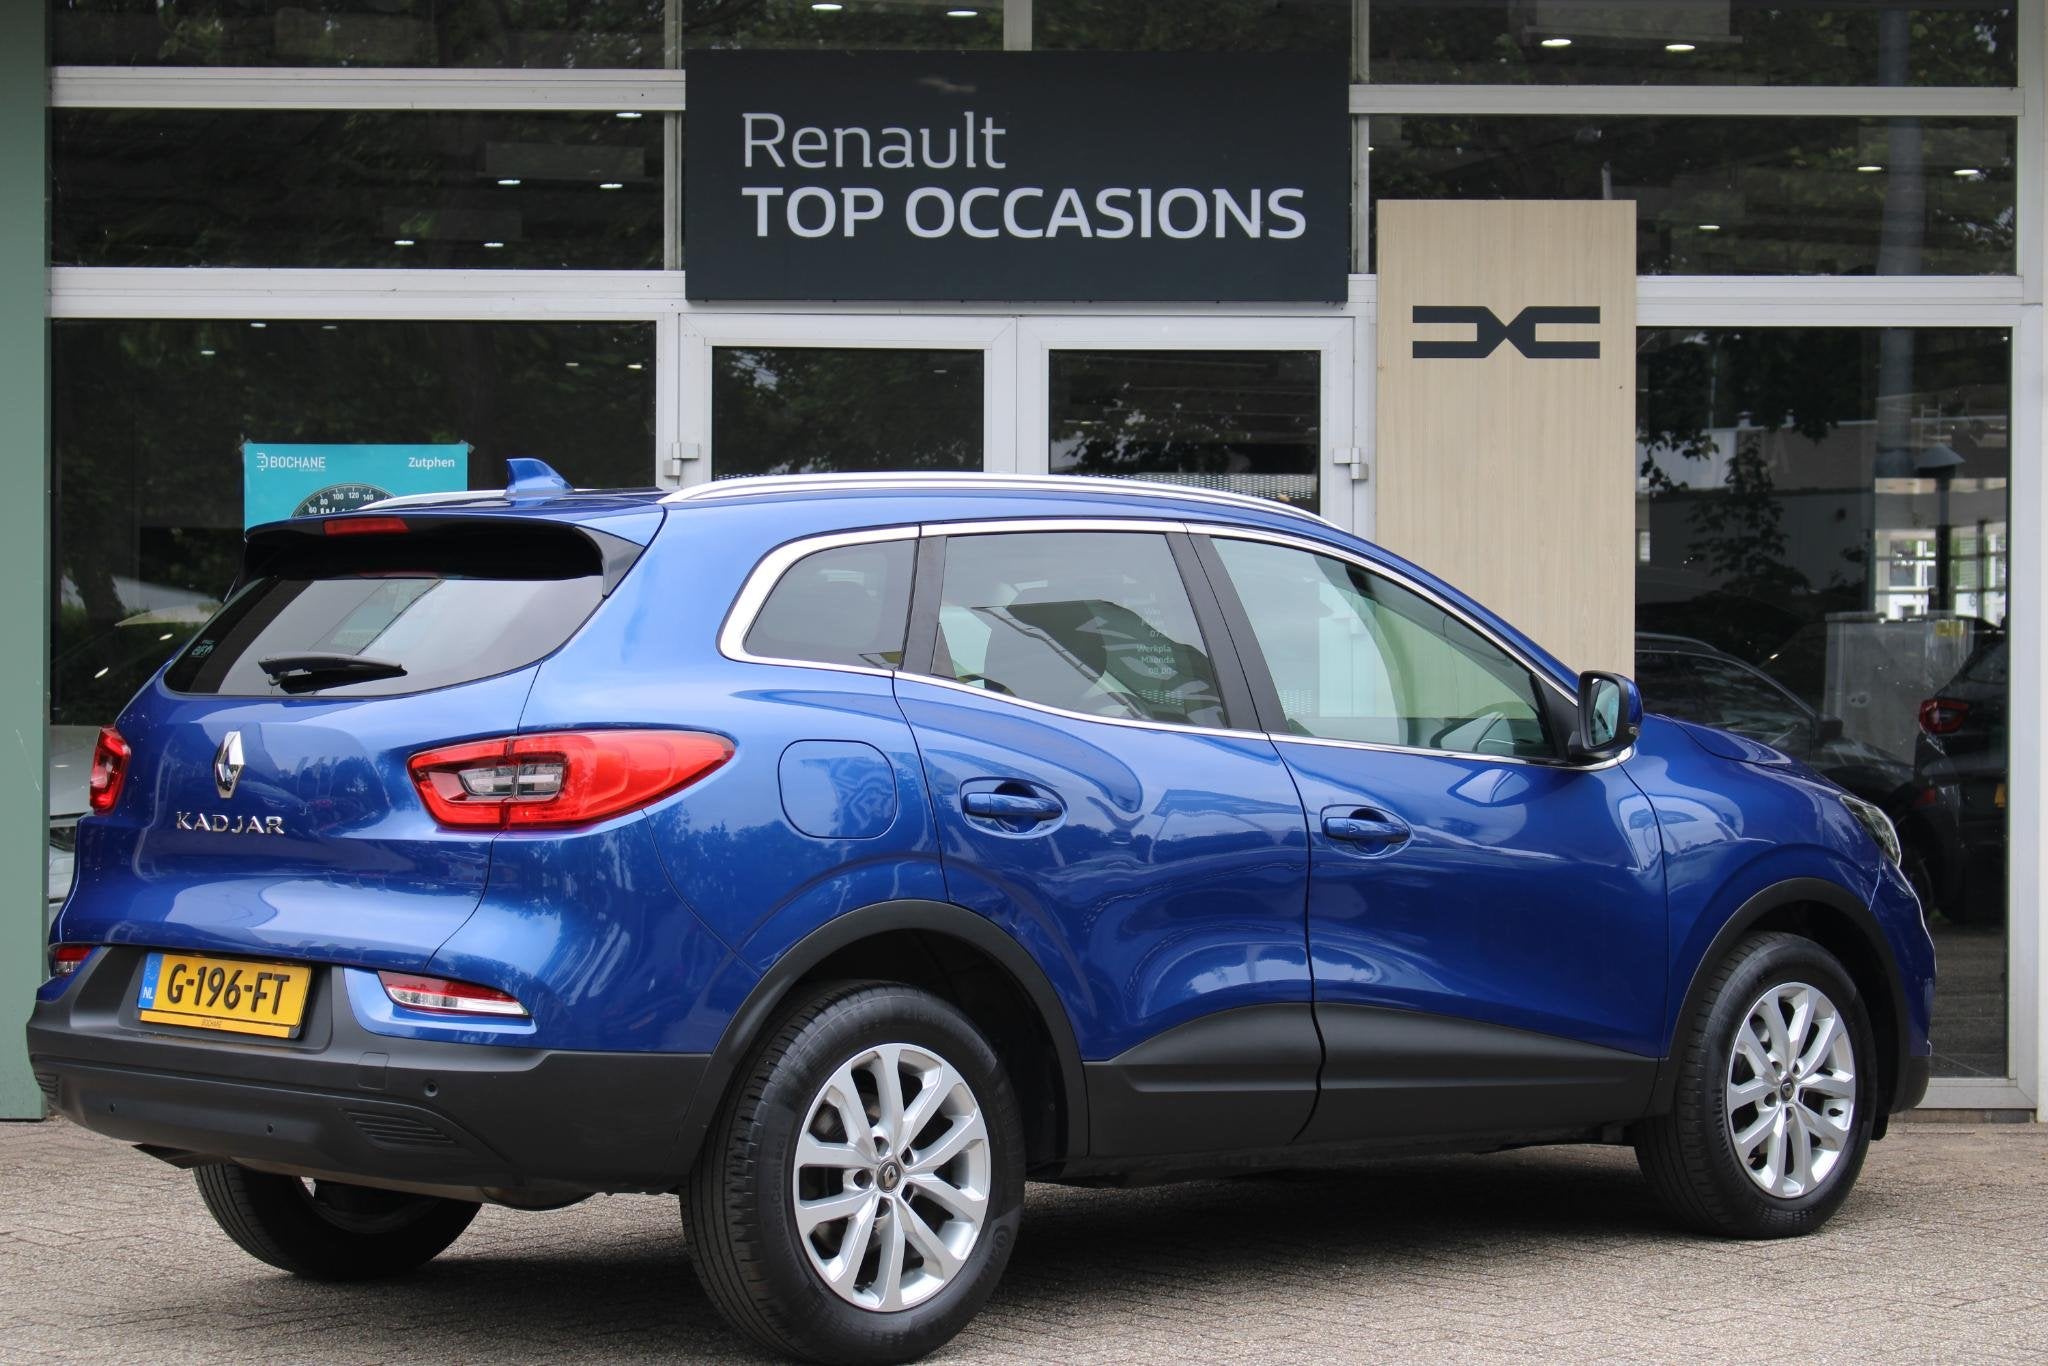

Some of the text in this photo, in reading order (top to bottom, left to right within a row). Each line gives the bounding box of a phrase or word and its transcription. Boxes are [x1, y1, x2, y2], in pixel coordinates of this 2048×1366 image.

[741, 110, 1006, 169] Renault
[741, 186, 1307, 239] TOP OCCASIONS
[270, 455, 326, 469] BOCHANE
[408, 456, 455, 471] Zutphen
[332, 492, 345, 501] 100
[348, 491, 360, 500] 120
[362, 493, 374, 502] 140
[176, 811, 285, 834] KADJAR
[142, 986, 154, 1000] NL
[167, 963, 290, 1015] G-196-FT
